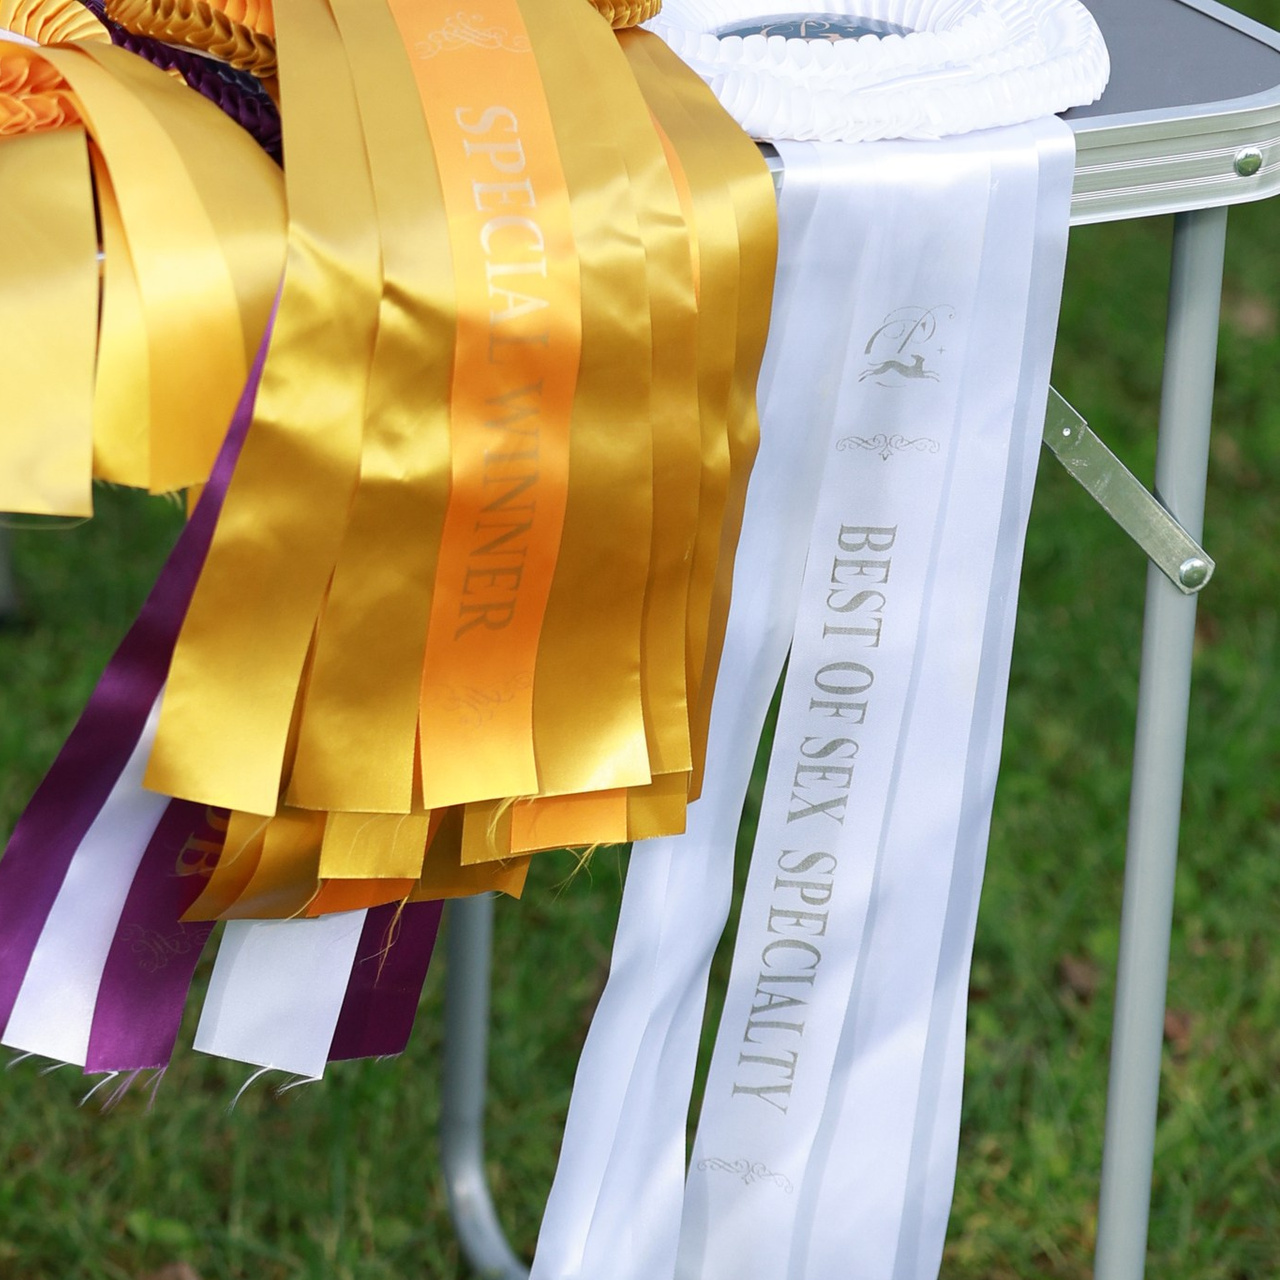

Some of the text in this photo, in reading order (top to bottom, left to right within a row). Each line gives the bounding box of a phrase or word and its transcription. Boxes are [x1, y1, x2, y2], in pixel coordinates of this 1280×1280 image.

[453, 105, 550, 642] SPECIAL WINNER
[731, 524, 897, 1114] BEST OF SEX SPECIALTY
